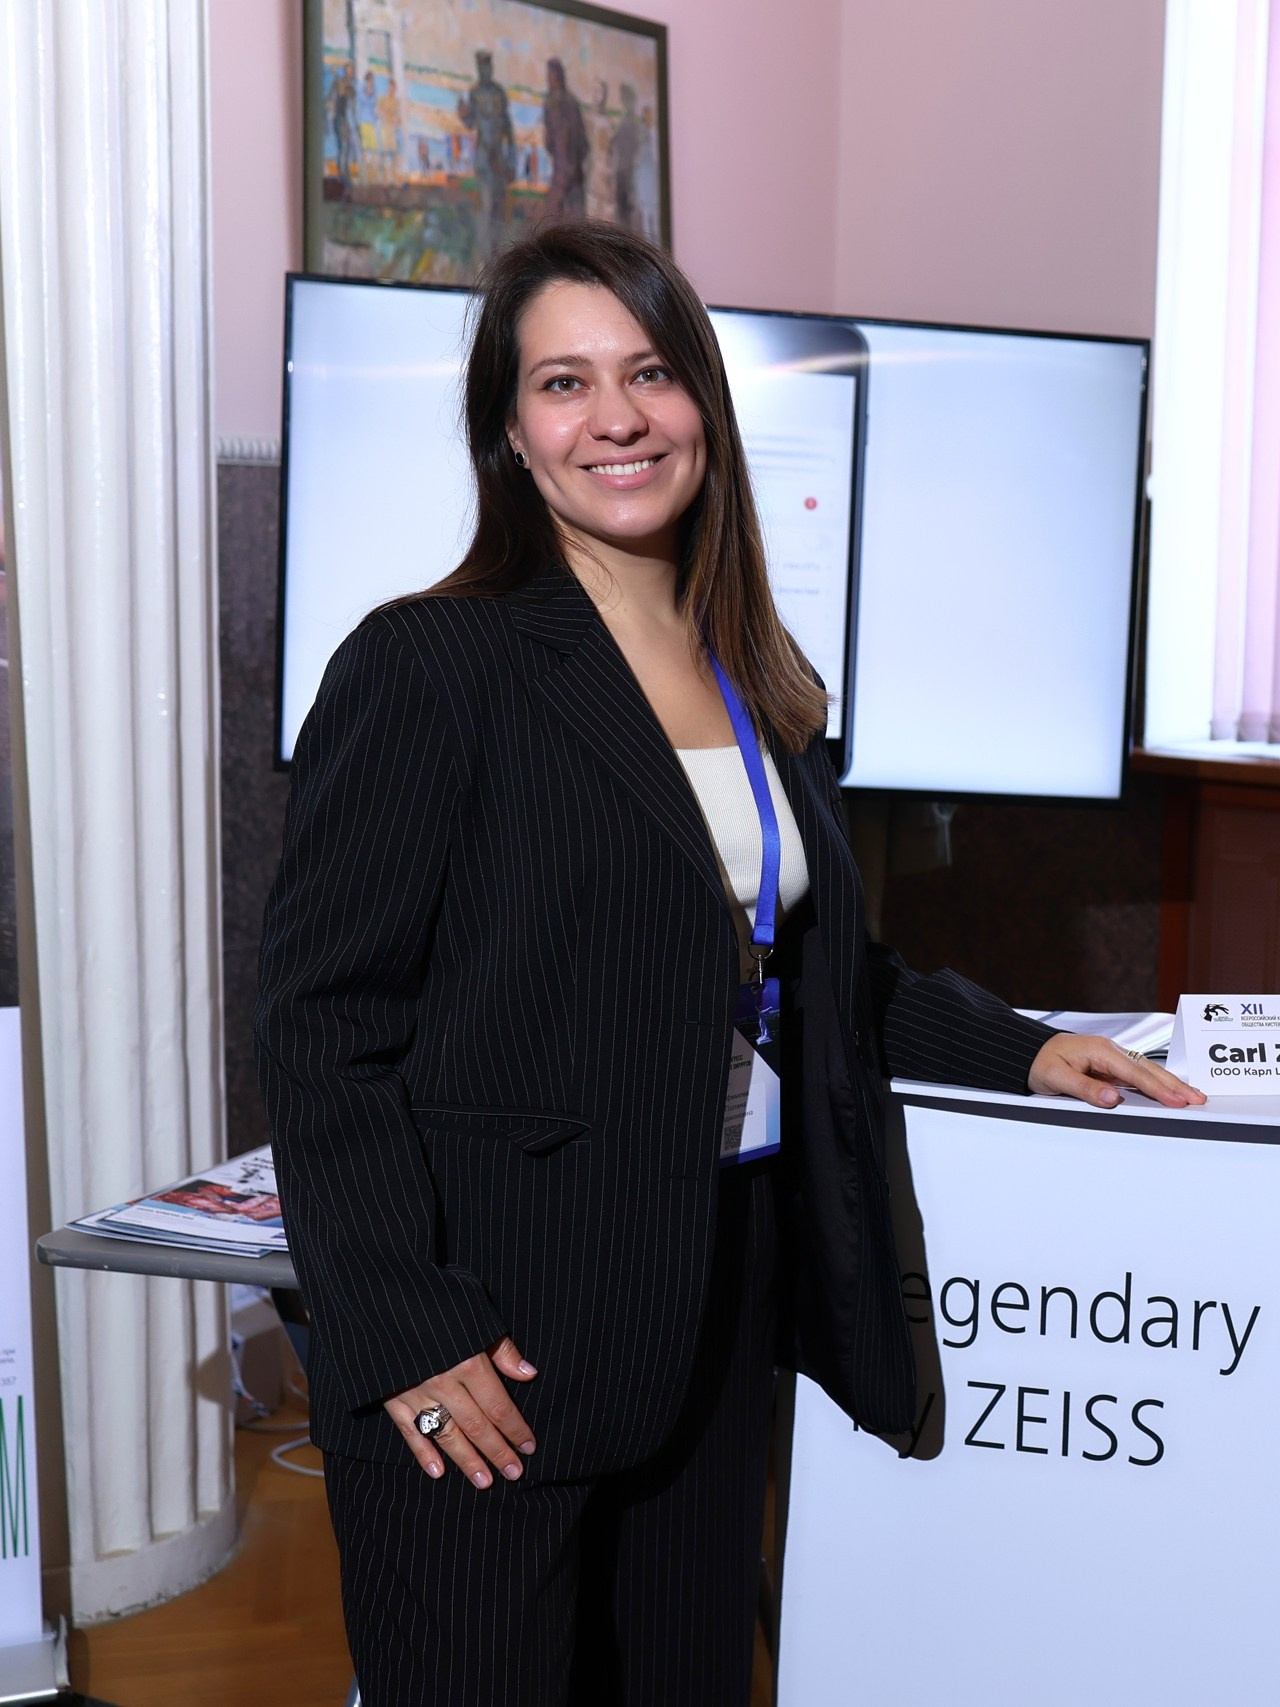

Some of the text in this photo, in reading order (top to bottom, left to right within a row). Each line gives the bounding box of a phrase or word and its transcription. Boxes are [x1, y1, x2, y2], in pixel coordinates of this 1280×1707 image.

[1240, 1003, 1263, 1015] XII
[1208, 1043, 1266, 1064] Carl
[1210, 1068, 1241, 1077] (ООО
[1244, 1067, 1272, 1077] Карл
[900, 1271, 1262, 1377] egendary
[964, 1380, 1166, 1467] ZEISS
